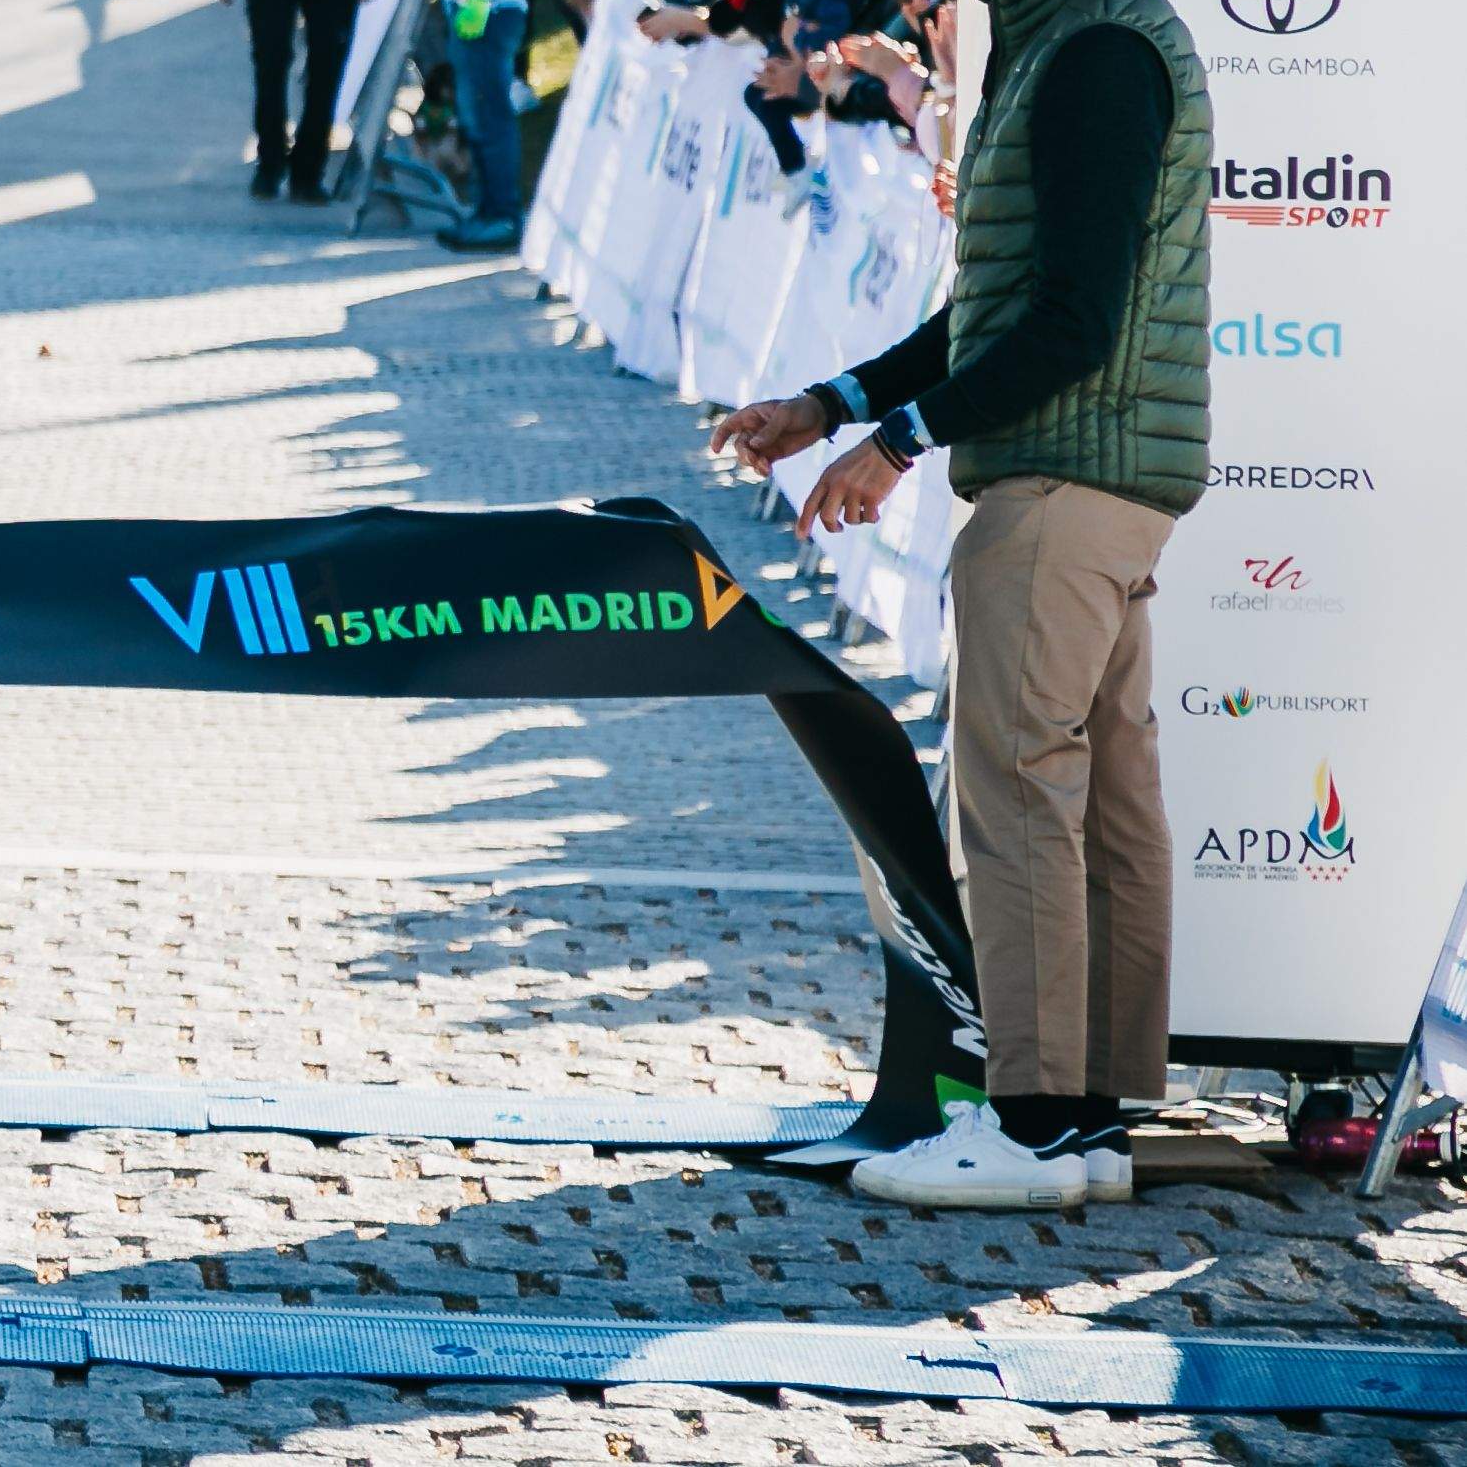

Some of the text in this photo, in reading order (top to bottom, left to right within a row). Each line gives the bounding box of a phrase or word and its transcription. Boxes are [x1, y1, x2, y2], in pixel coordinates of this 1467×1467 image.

[1206, 57, 1375, 77] UPRA GAMBOA
[1211, 154, 1392, 202] italdin
[1286, 207, 1391, 229] SPORT
[1212, 313, 1342, 359] alsa
[129, 562, 695, 656] VIII 15KM MADRID
[1256, 694, 1370, 713] PUBLISPORT
[1194, 827, 1356, 865] APDM
